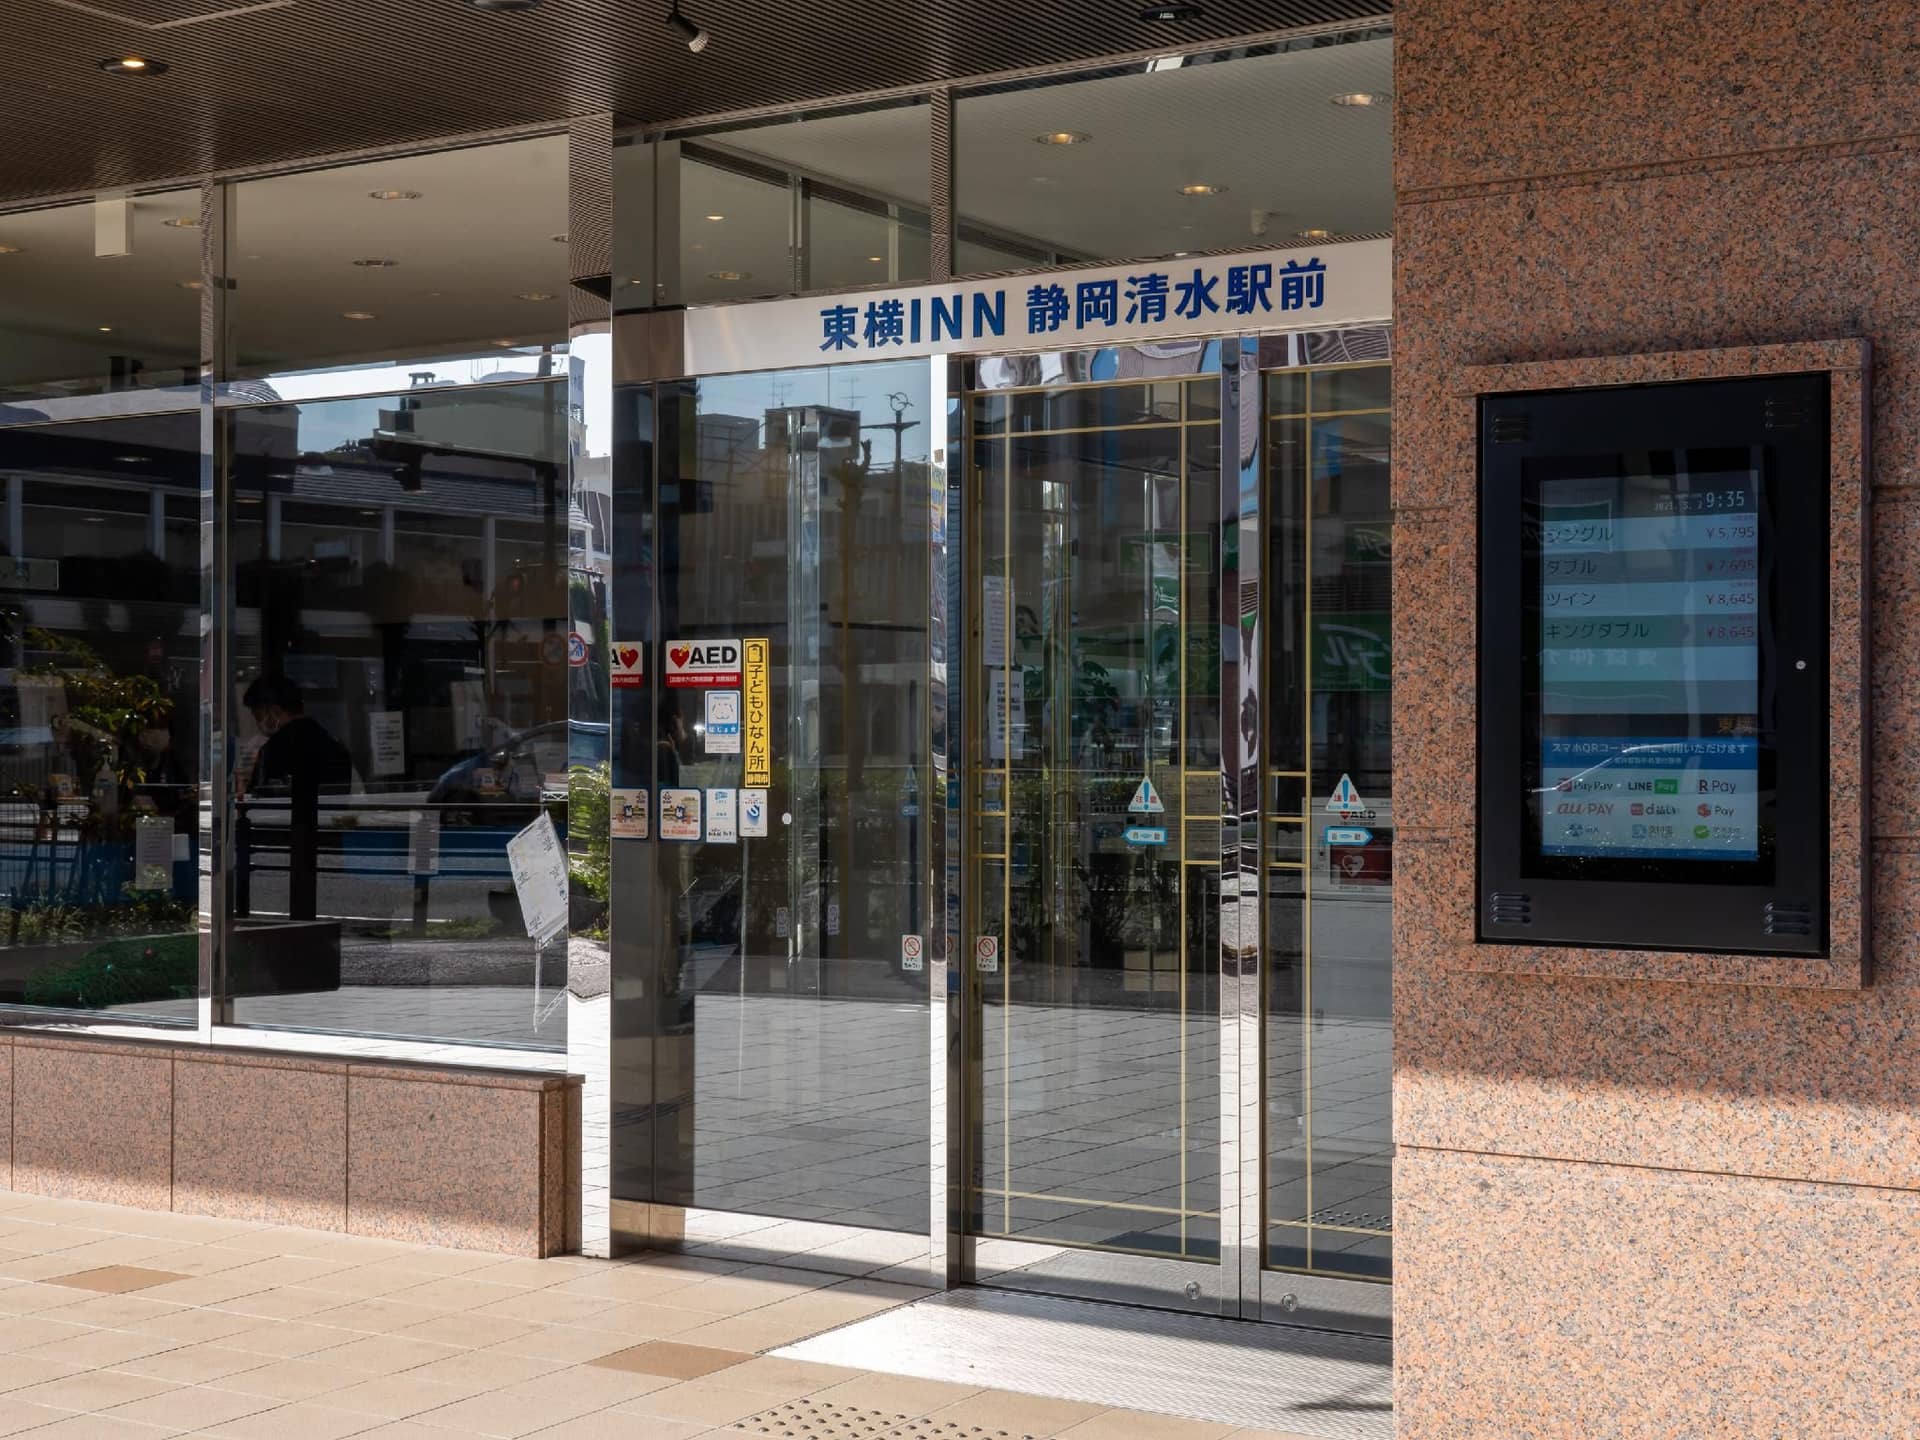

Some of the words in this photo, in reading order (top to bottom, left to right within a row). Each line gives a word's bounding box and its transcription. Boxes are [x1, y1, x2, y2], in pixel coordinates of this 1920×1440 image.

[818, 290, 1006, 352] 東横INN
[1026, 257, 1327, 333] 静岡清水駅前
[1705, 491, 1744, 508] 9:35
[1544, 525, 1613, 542] シングル
[1546, 559, 1597, 575] ダブル
[1546, 592, 1596, 606] ツイン
[1545, 621, 1650, 639] キングダブル
[689, 646, 738, 664] AED
[748, 664, 765, 771] 子どもひなん所
[1628, 782, 1653, 791] LINE
[1711, 780, 1736, 795] Pay
[1587, 803, 1614, 815] PAY
[1714, 806, 1735, 817] Pay
